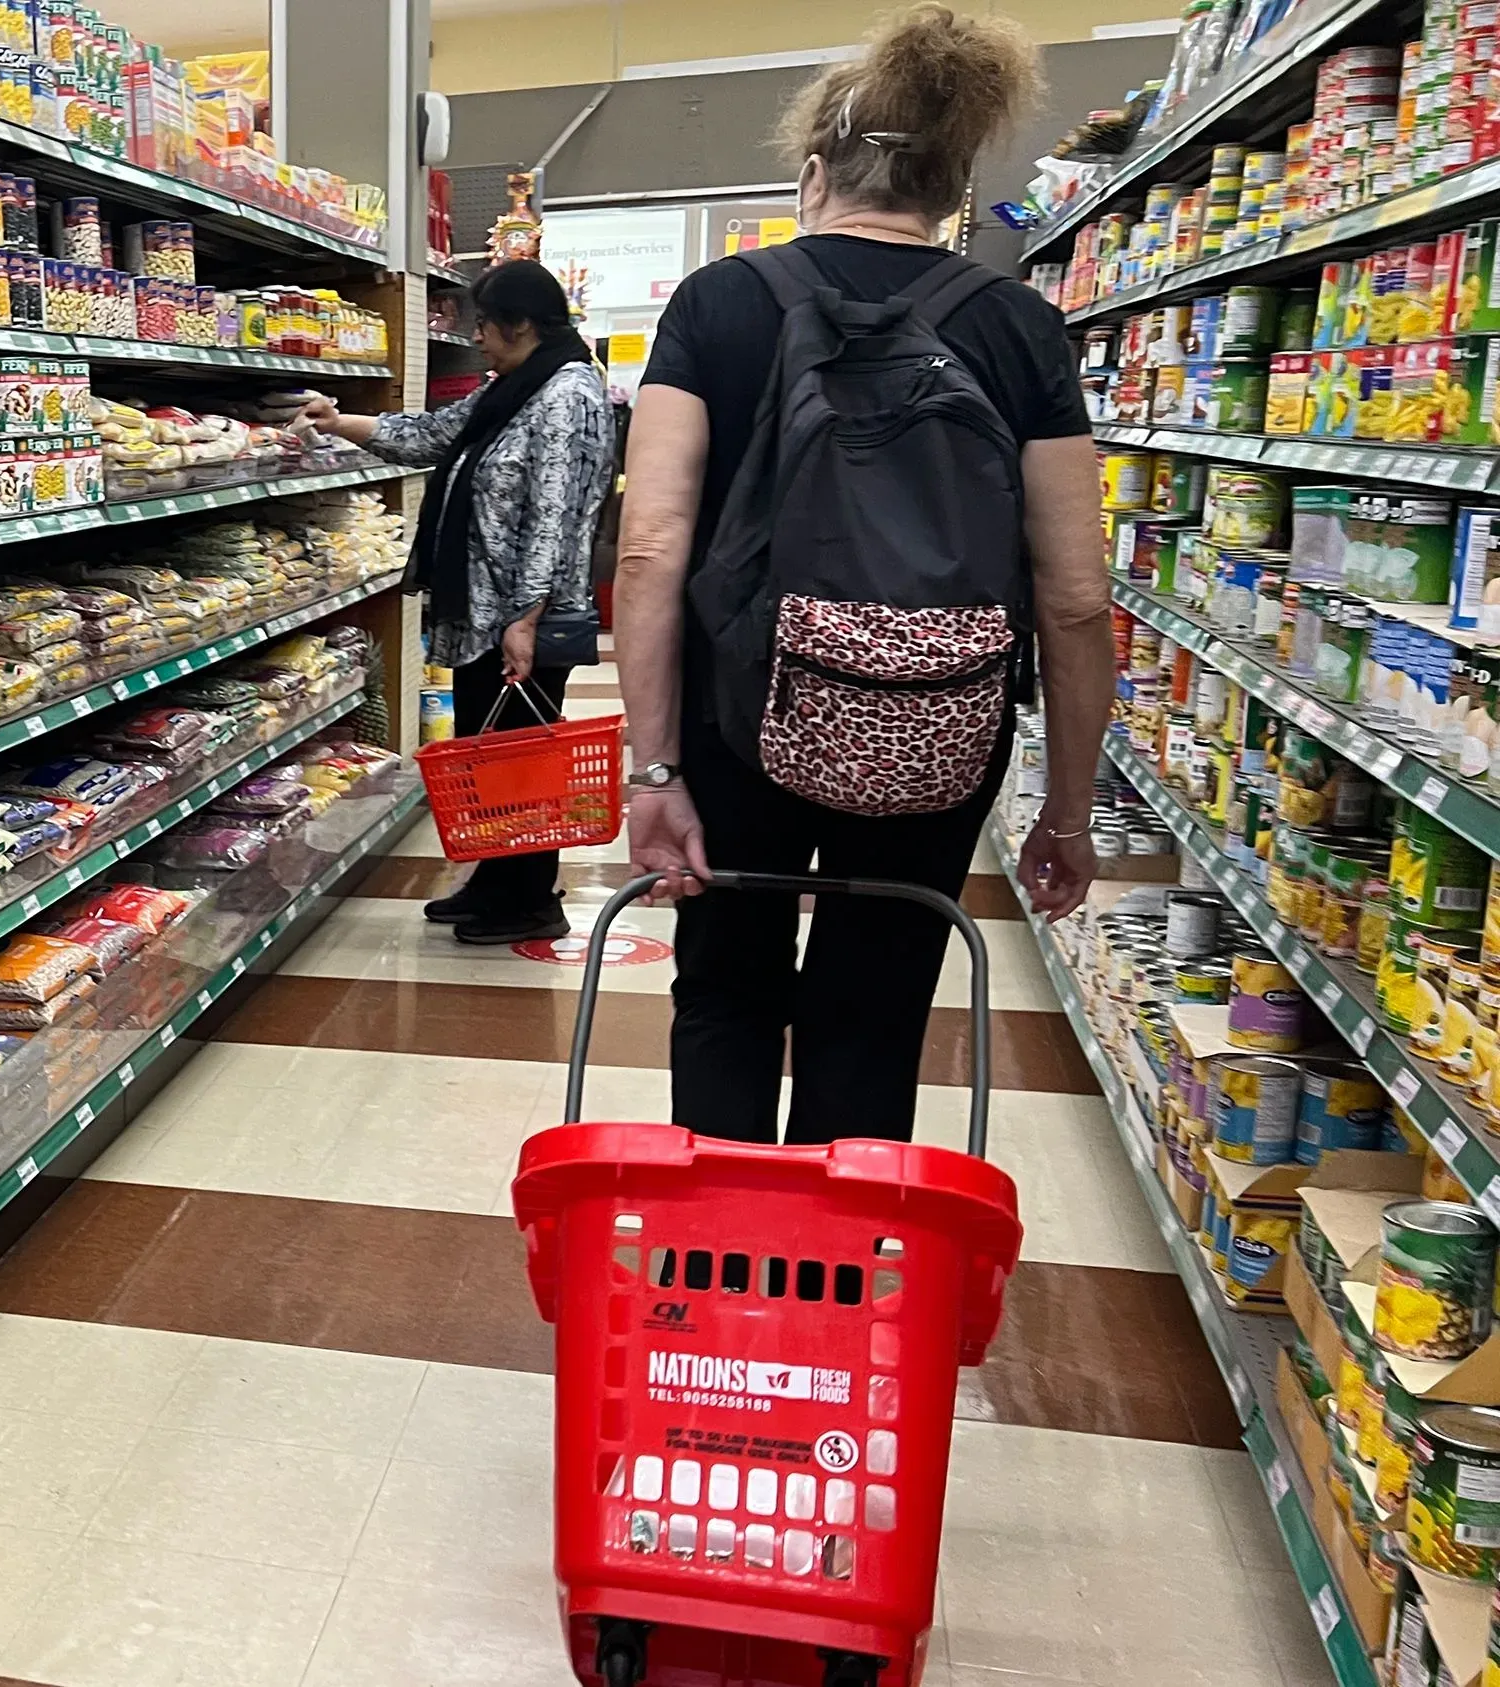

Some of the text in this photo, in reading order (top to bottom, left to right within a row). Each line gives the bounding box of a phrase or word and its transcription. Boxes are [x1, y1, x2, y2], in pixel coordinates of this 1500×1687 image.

[544, 241, 674, 262] Employment Services
[649, 1350, 851, 1393] NATIONS FRESH
[812, 1384, 850, 1405] FOODS
